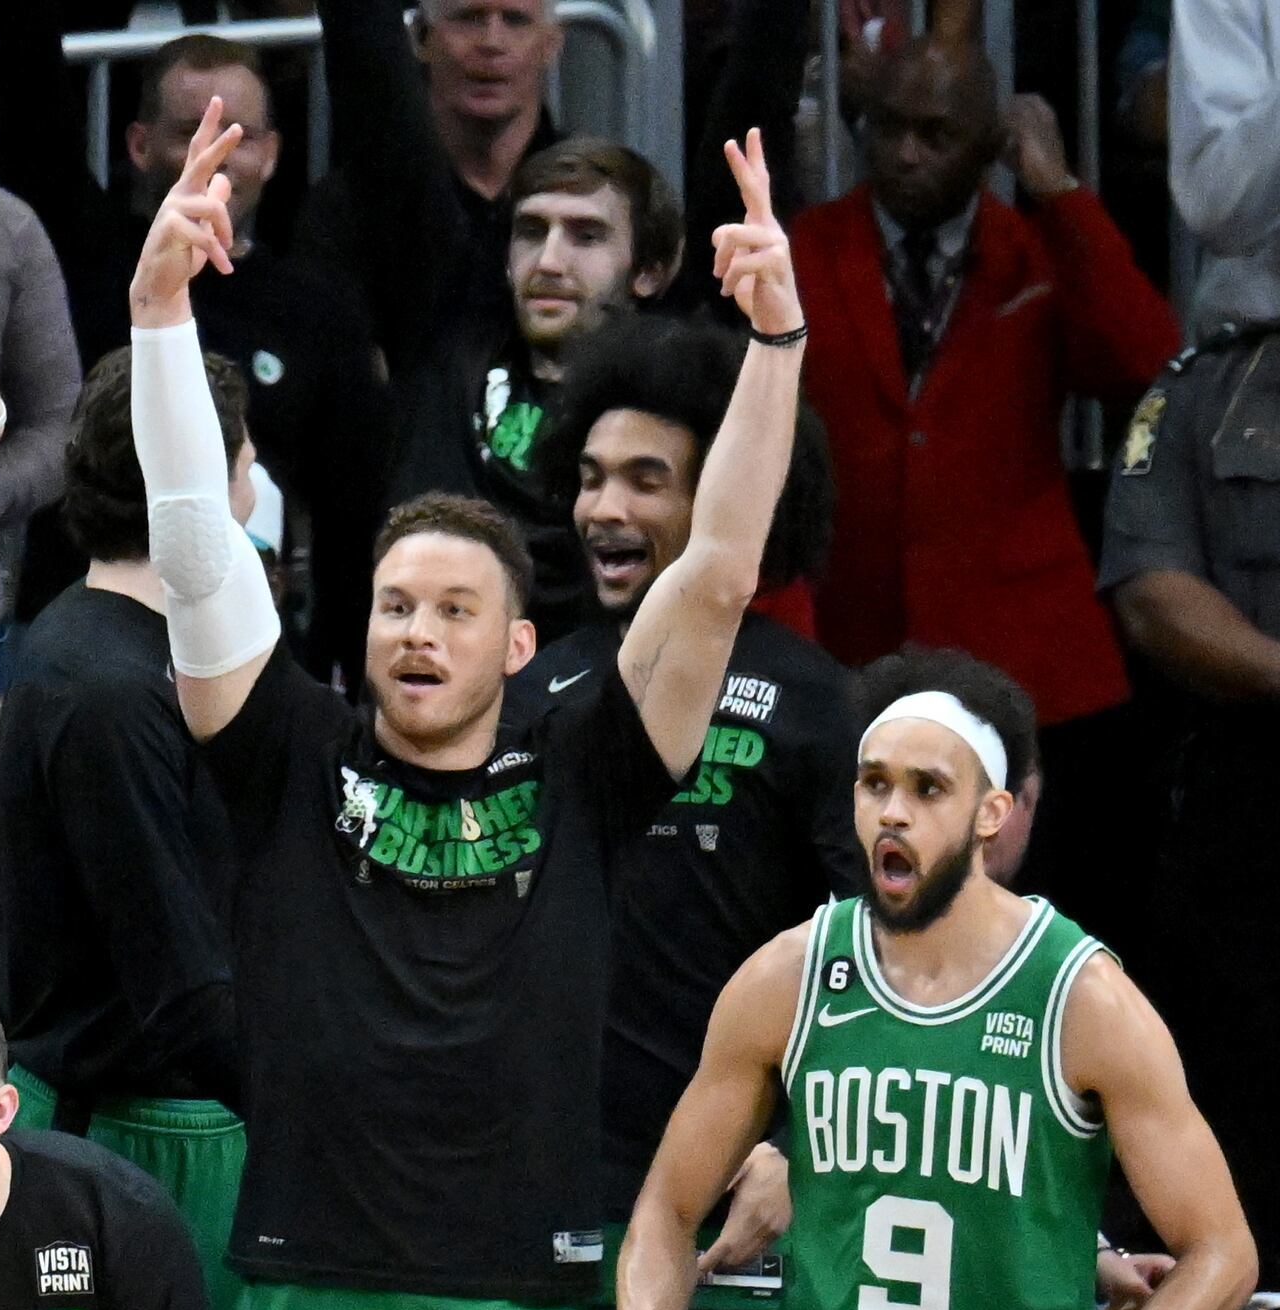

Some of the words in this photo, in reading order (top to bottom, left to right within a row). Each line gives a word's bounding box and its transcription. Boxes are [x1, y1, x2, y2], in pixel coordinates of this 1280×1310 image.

[727, 675, 777, 707] VISTA
[719, 696, 771, 721] PRINT
[828, 961, 849, 990] 6
[985, 1011, 1034, 1041] VISTA
[981, 1034, 1032, 1059] PRINT
[805, 1066, 1032, 1198] BOSTON
[38, 1247, 90, 1274] VISTA
[40, 1273, 90, 1293] PRINT
